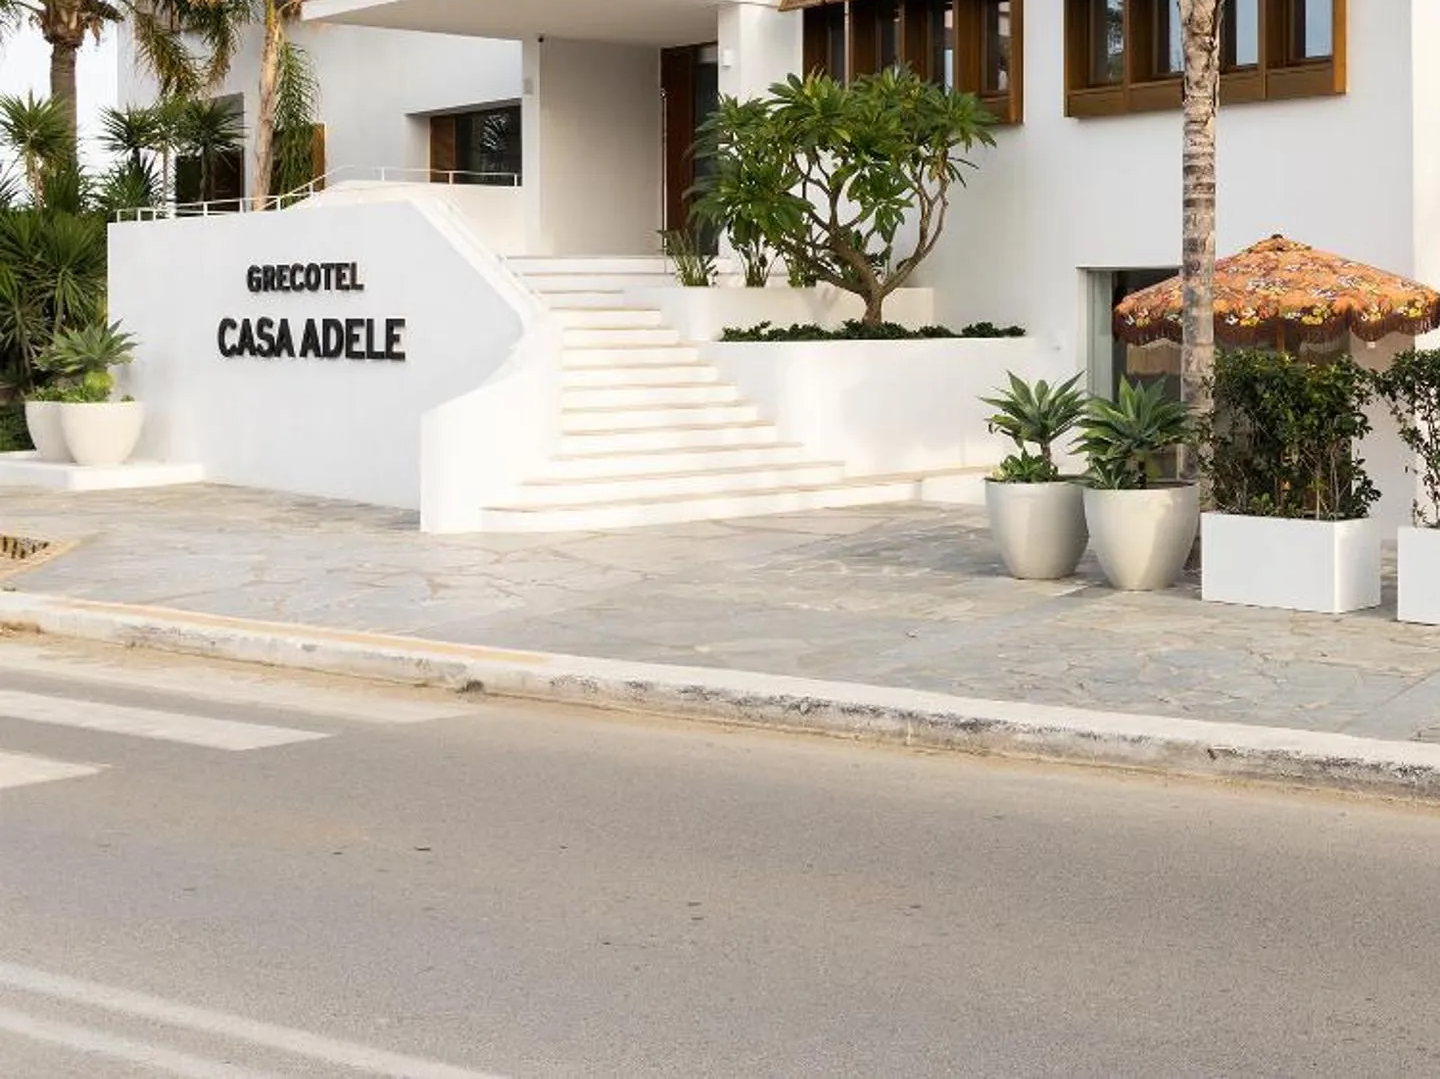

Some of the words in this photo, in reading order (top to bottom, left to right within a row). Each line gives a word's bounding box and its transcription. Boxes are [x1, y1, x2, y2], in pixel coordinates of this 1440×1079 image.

[247, 261, 364, 292] GRECOTEL
[218, 317, 296, 358] CASA
[299, 318, 406, 361] ADELE
